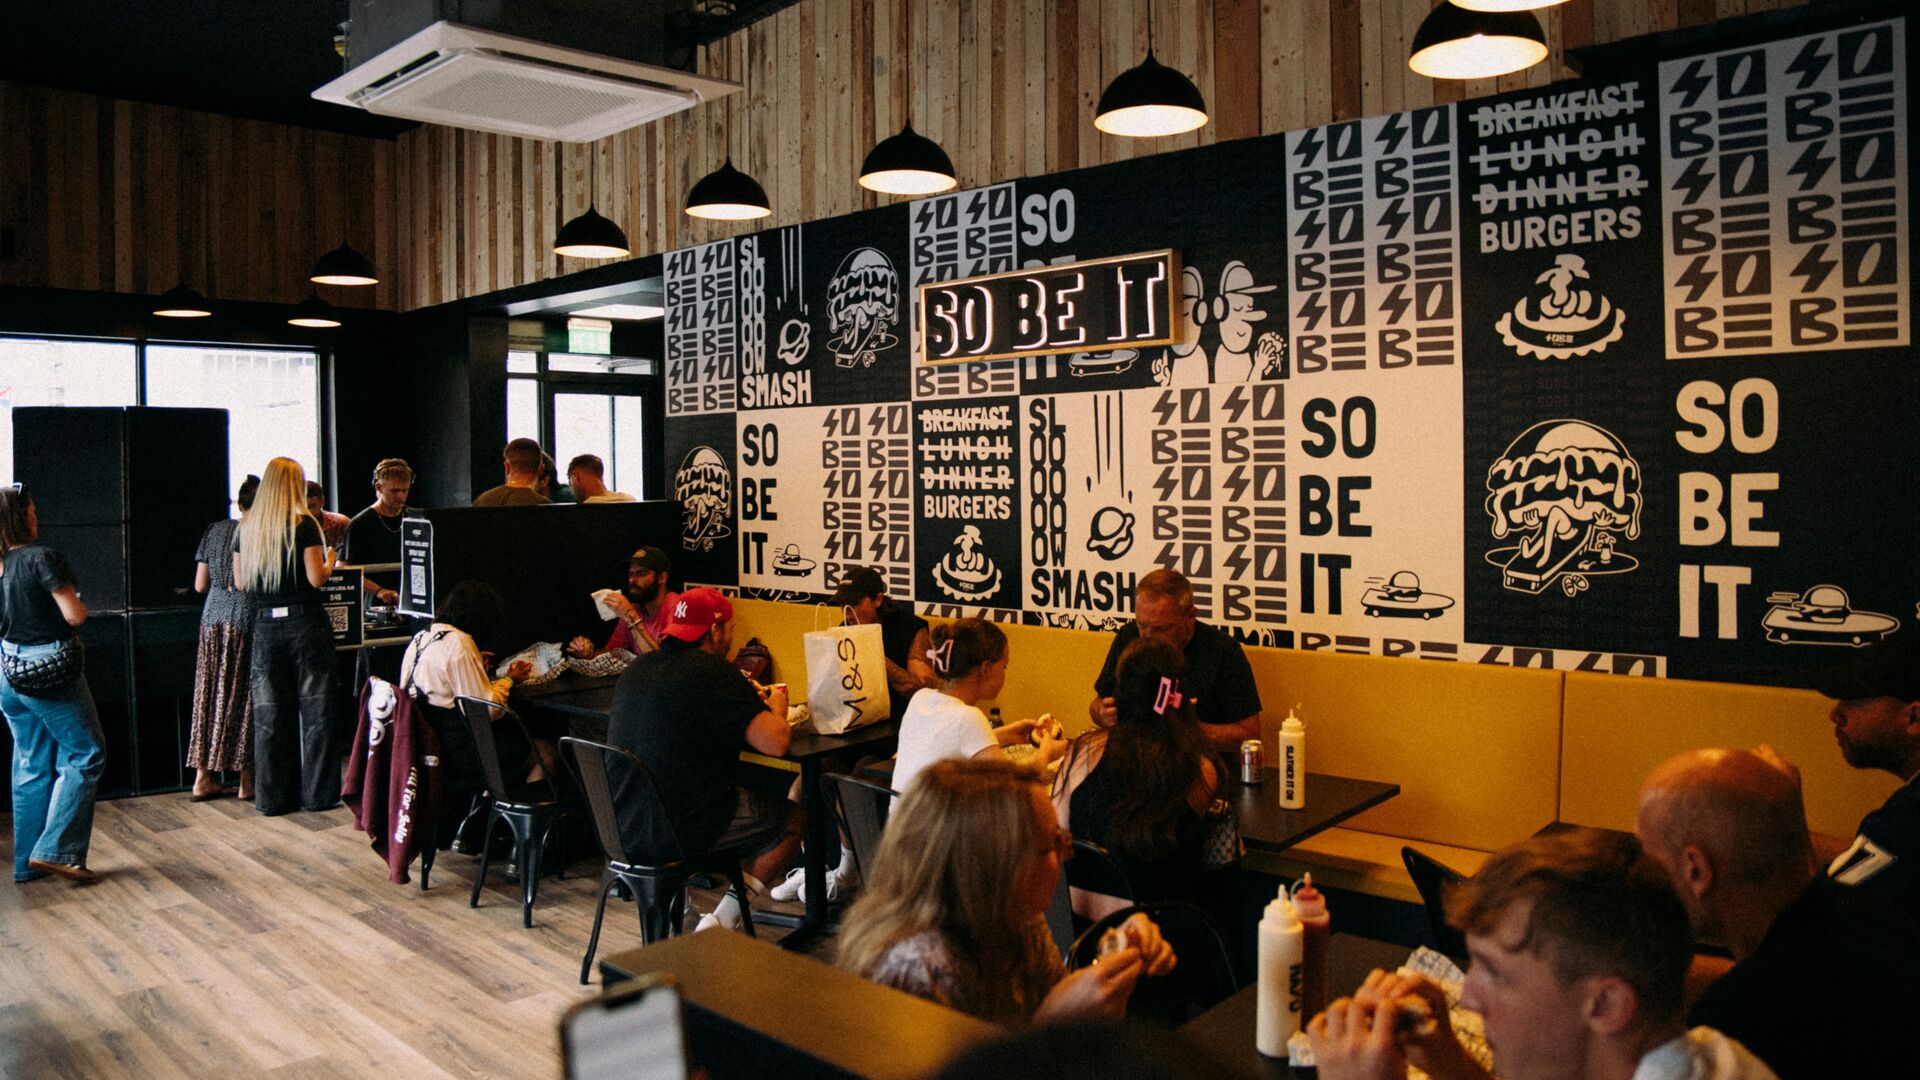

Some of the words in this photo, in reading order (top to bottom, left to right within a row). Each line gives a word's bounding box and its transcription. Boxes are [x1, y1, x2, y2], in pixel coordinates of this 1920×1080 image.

[1669, 49, 1766, 108] SO
[1785, 25, 1893, 89] SO
[1476, 81, 1640, 138] BREAKFAST
[1670, 101, 1767, 159] BE
[1785, 80, 1894, 142] BE
[1293, 120, 1361, 168] SO
[1375, 104, 1449, 155] SO
[1477, 123, 1641, 176] LUNCH
[1294, 164, 1363, 210] BE
[1375, 150, 1450, 199] BE
[1478, 164, 1643, 214] DINNER
[1671, 149, 1769, 205] SO
[1787, 131, 1895, 191] SO
[914, 196, 958, 233] SO
[966, 186, 1012, 224] SO
[1021, 188, 1075, 246] SO
[1295, 204, 1364, 249] SO
[1377, 192, 1451, 240] SO
[1480, 206, 1641, 253] BURGERS
[1672, 202, 1770, 255] BE
[1787, 187, 1896, 244] BE
[667, 249, 696, 279] SO
[701, 241, 732, 272] SO
[914, 231, 958, 267] BE
[965, 222, 1012, 259] BE
[1295, 248, 1364, 292] BE
[1377, 238, 1452, 284] BE
[667, 278, 697, 307] BE
[701, 271, 733, 301] BE
[1674, 250, 1771, 302] SO
[1789, 237, 1897, 293] SO
[667, 303, 698, 332] SO
[702, 297, 733, 328] SO
[927, 286, 993, 357] SO
[1009, 272, 1085, 349] BE
[1105, 262, 1165, 341] IT
[1296, 288, 1365, 331] SO
[1378, 280, 1453, 325] SO
[1675, 302, 1772, 353] BE
[1790, 293, 1898, 345] BE
[667, 332, 698, 360] BE
[702, 327, 733, 356] BE
[1297, 332, 1366, 373] BE
[1379, 326, 1454, 369] BE
[669, 358, 698, 386] SO
[703, 353, 734, 382] SO
[742, 369, 812, 407] SMASH
[916, 364, 959, 397] BE
[967, 361, 1014, 394] BE
[669, 387, 698, 413] BE
[703, 383, 735, 411] BE
[922, 406, 1010, 432] BREAKFAST
[1151, 388, 1210, 425] SO
[1222, 384, 1285, 423] SO
[1675, 377, 1779, 454] SO
[823, 408, 860, 437] SO
[867, 405, 908, 436] SO
[1301, 396, 1376, 459] SO
[743, 423, 778, 467] SO
[823, 440, 860, 468] BE
[867, 439, 908, 468] BE
[923, 436, 1010, 461] LUNCH
[1152, 429, 1211, 464] BE
[1222, 426, 1285, 463] BE
[742, 478, 777, 521] BE
[823, 470, 861, 498] SO
[868, 470, 909, 499] SO
[923, 465, 1011, 490] DINNER
[1152, 466, 1211, 501] SO
[1222, 465, 1285, 501] SO
[823, 502, 862, 530] BE
[869, 502, 909, 532] BE
[924, 495, 1011, 520] BURGERS
[1153, 505, 1212, 540] BE
[1222, 506, 1286, 543] BE
[1300, 475, 1371, 537] BE
[1679, 471, 1780, 547] BE
[743, 532, 768, 575] IT
[824, 531, 862, 559] SO
[869, 533, 910, 562] SO
[1154, 543, 1212, 578] SO
[1223, 545, 1286, 582] SO
[1031, 568, 1135, 613] SMASH
[1223, 584, 1287, 624] BE
[1301, 553, 1351, 616] IT
[1679, 564, 1751, 639] IT
[838, 638, 867, 731] M&S
